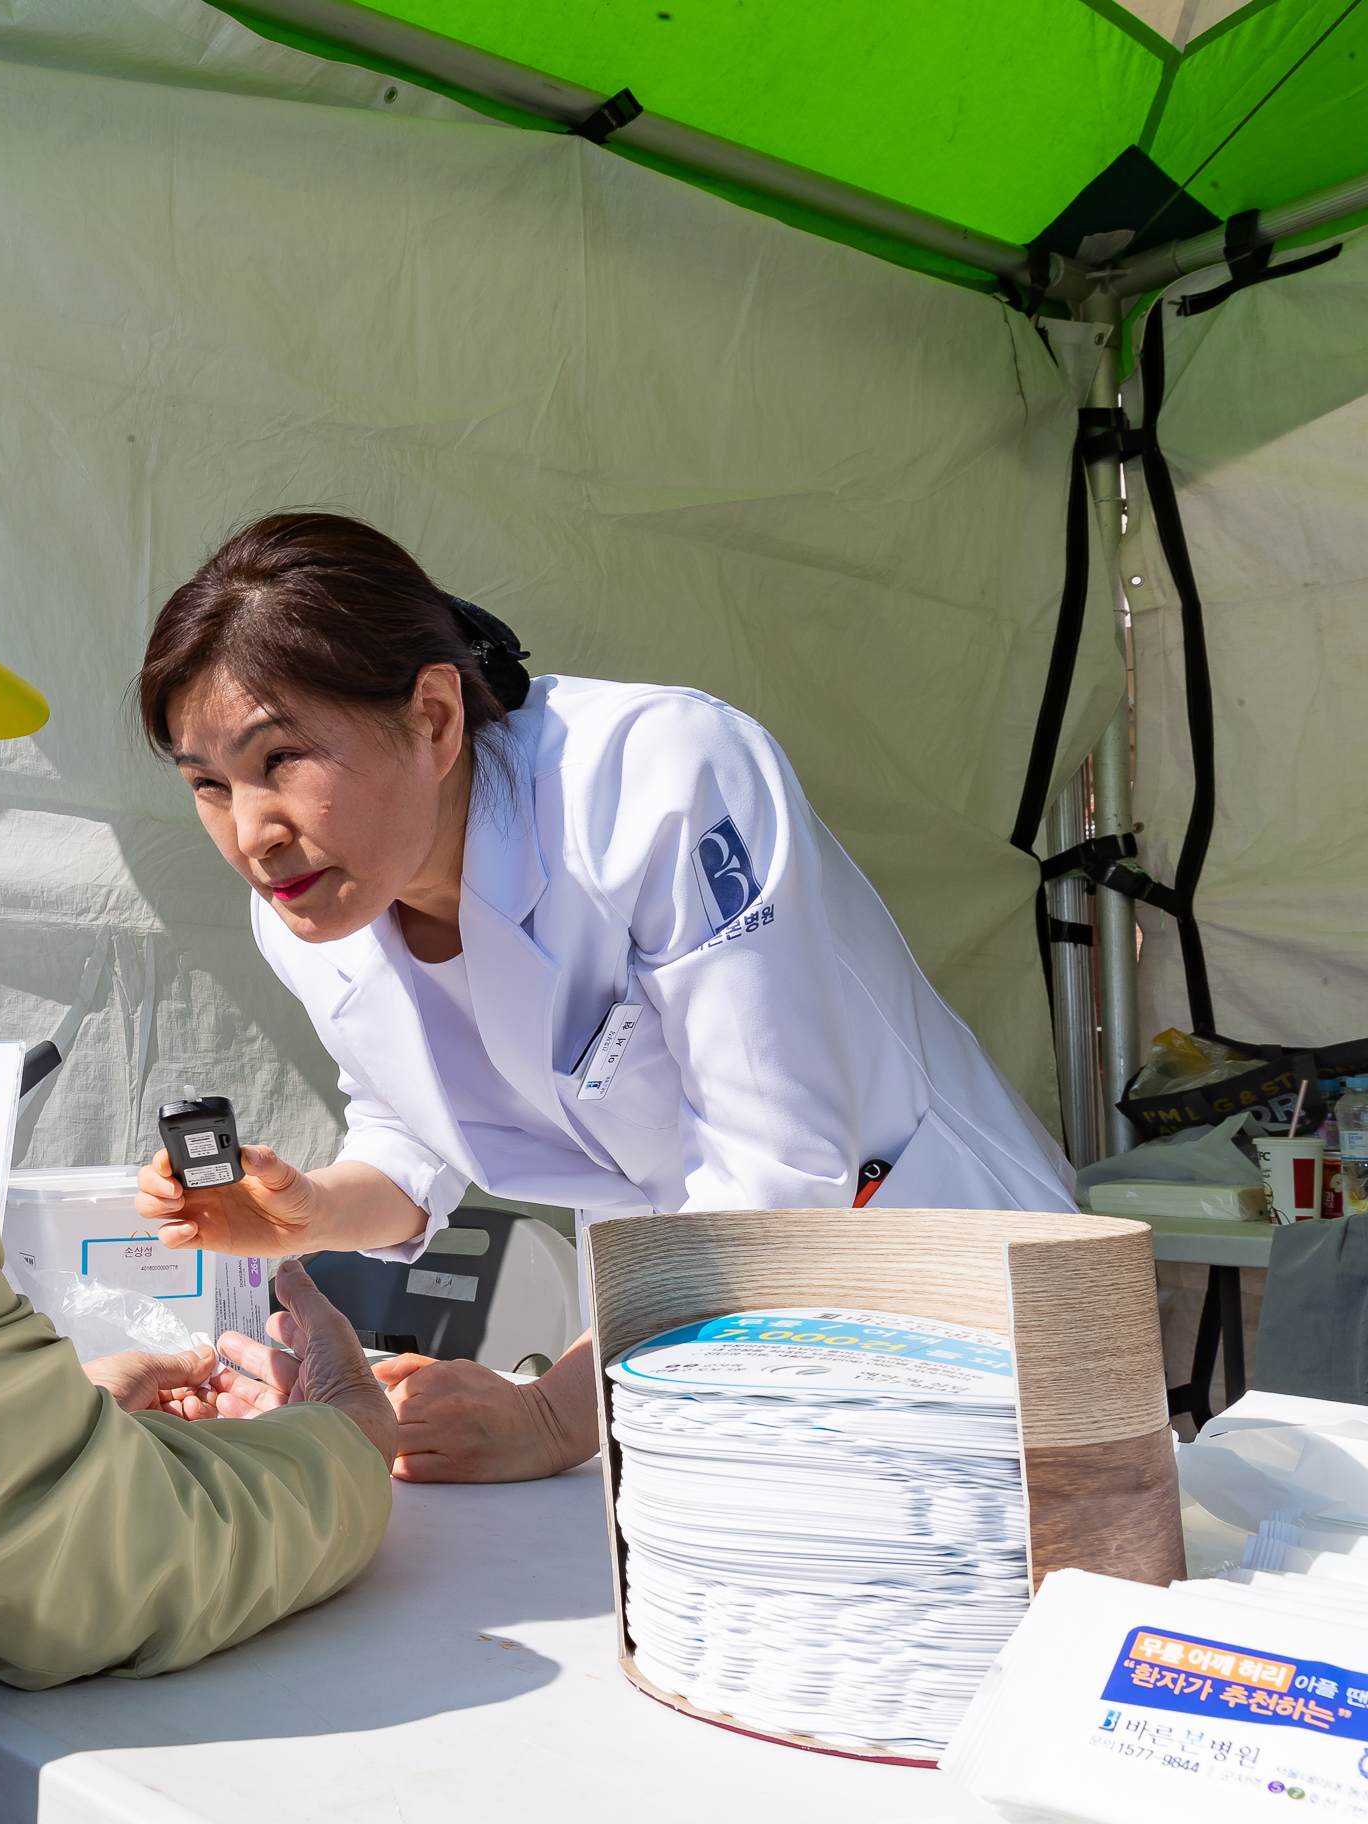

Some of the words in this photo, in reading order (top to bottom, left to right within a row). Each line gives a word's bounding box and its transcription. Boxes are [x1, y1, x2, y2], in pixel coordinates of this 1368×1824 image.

[695, 903, 774, 951] 본병원
[1238, 1090, 1258, 1106] &
[1258, 1151, 1271, 1161] FC
[125, 1246, 153, 1258] 손상성
[862, 1328, 943, 1345] 어깨
[1138, 1637, 1185, 1664] 무릎
[1188, 1648, 1236, 1677] 어깨
[1238, 1658, 1287, 1688] 허리
[1294, 1675, 1339, 1700] 아플
[1089, 1735, 1116, 1751] 문의
[1118, 1742, 1200, 1774] 1577-9844
[1125, 1718, 1261, 1770] 바른본병원
